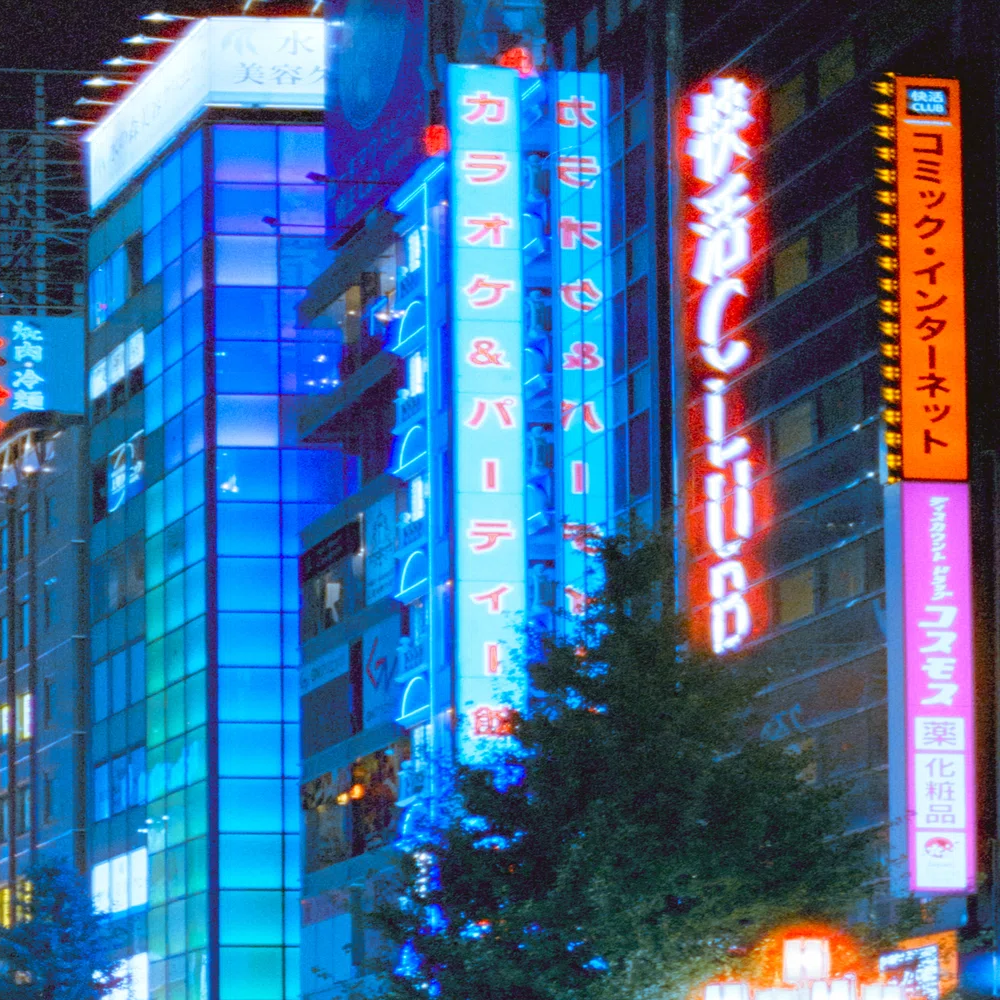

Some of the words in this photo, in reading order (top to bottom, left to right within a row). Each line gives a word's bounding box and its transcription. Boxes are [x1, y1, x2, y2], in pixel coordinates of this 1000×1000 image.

[911, 103, 945, 113] CLUB
[912, 132, 952, 454] コミック・インターネット
[917, 605, 959, 706] コスモス
[923, 721, 957, 747] 薬
[924, 757, 957, 824] 化粧品
